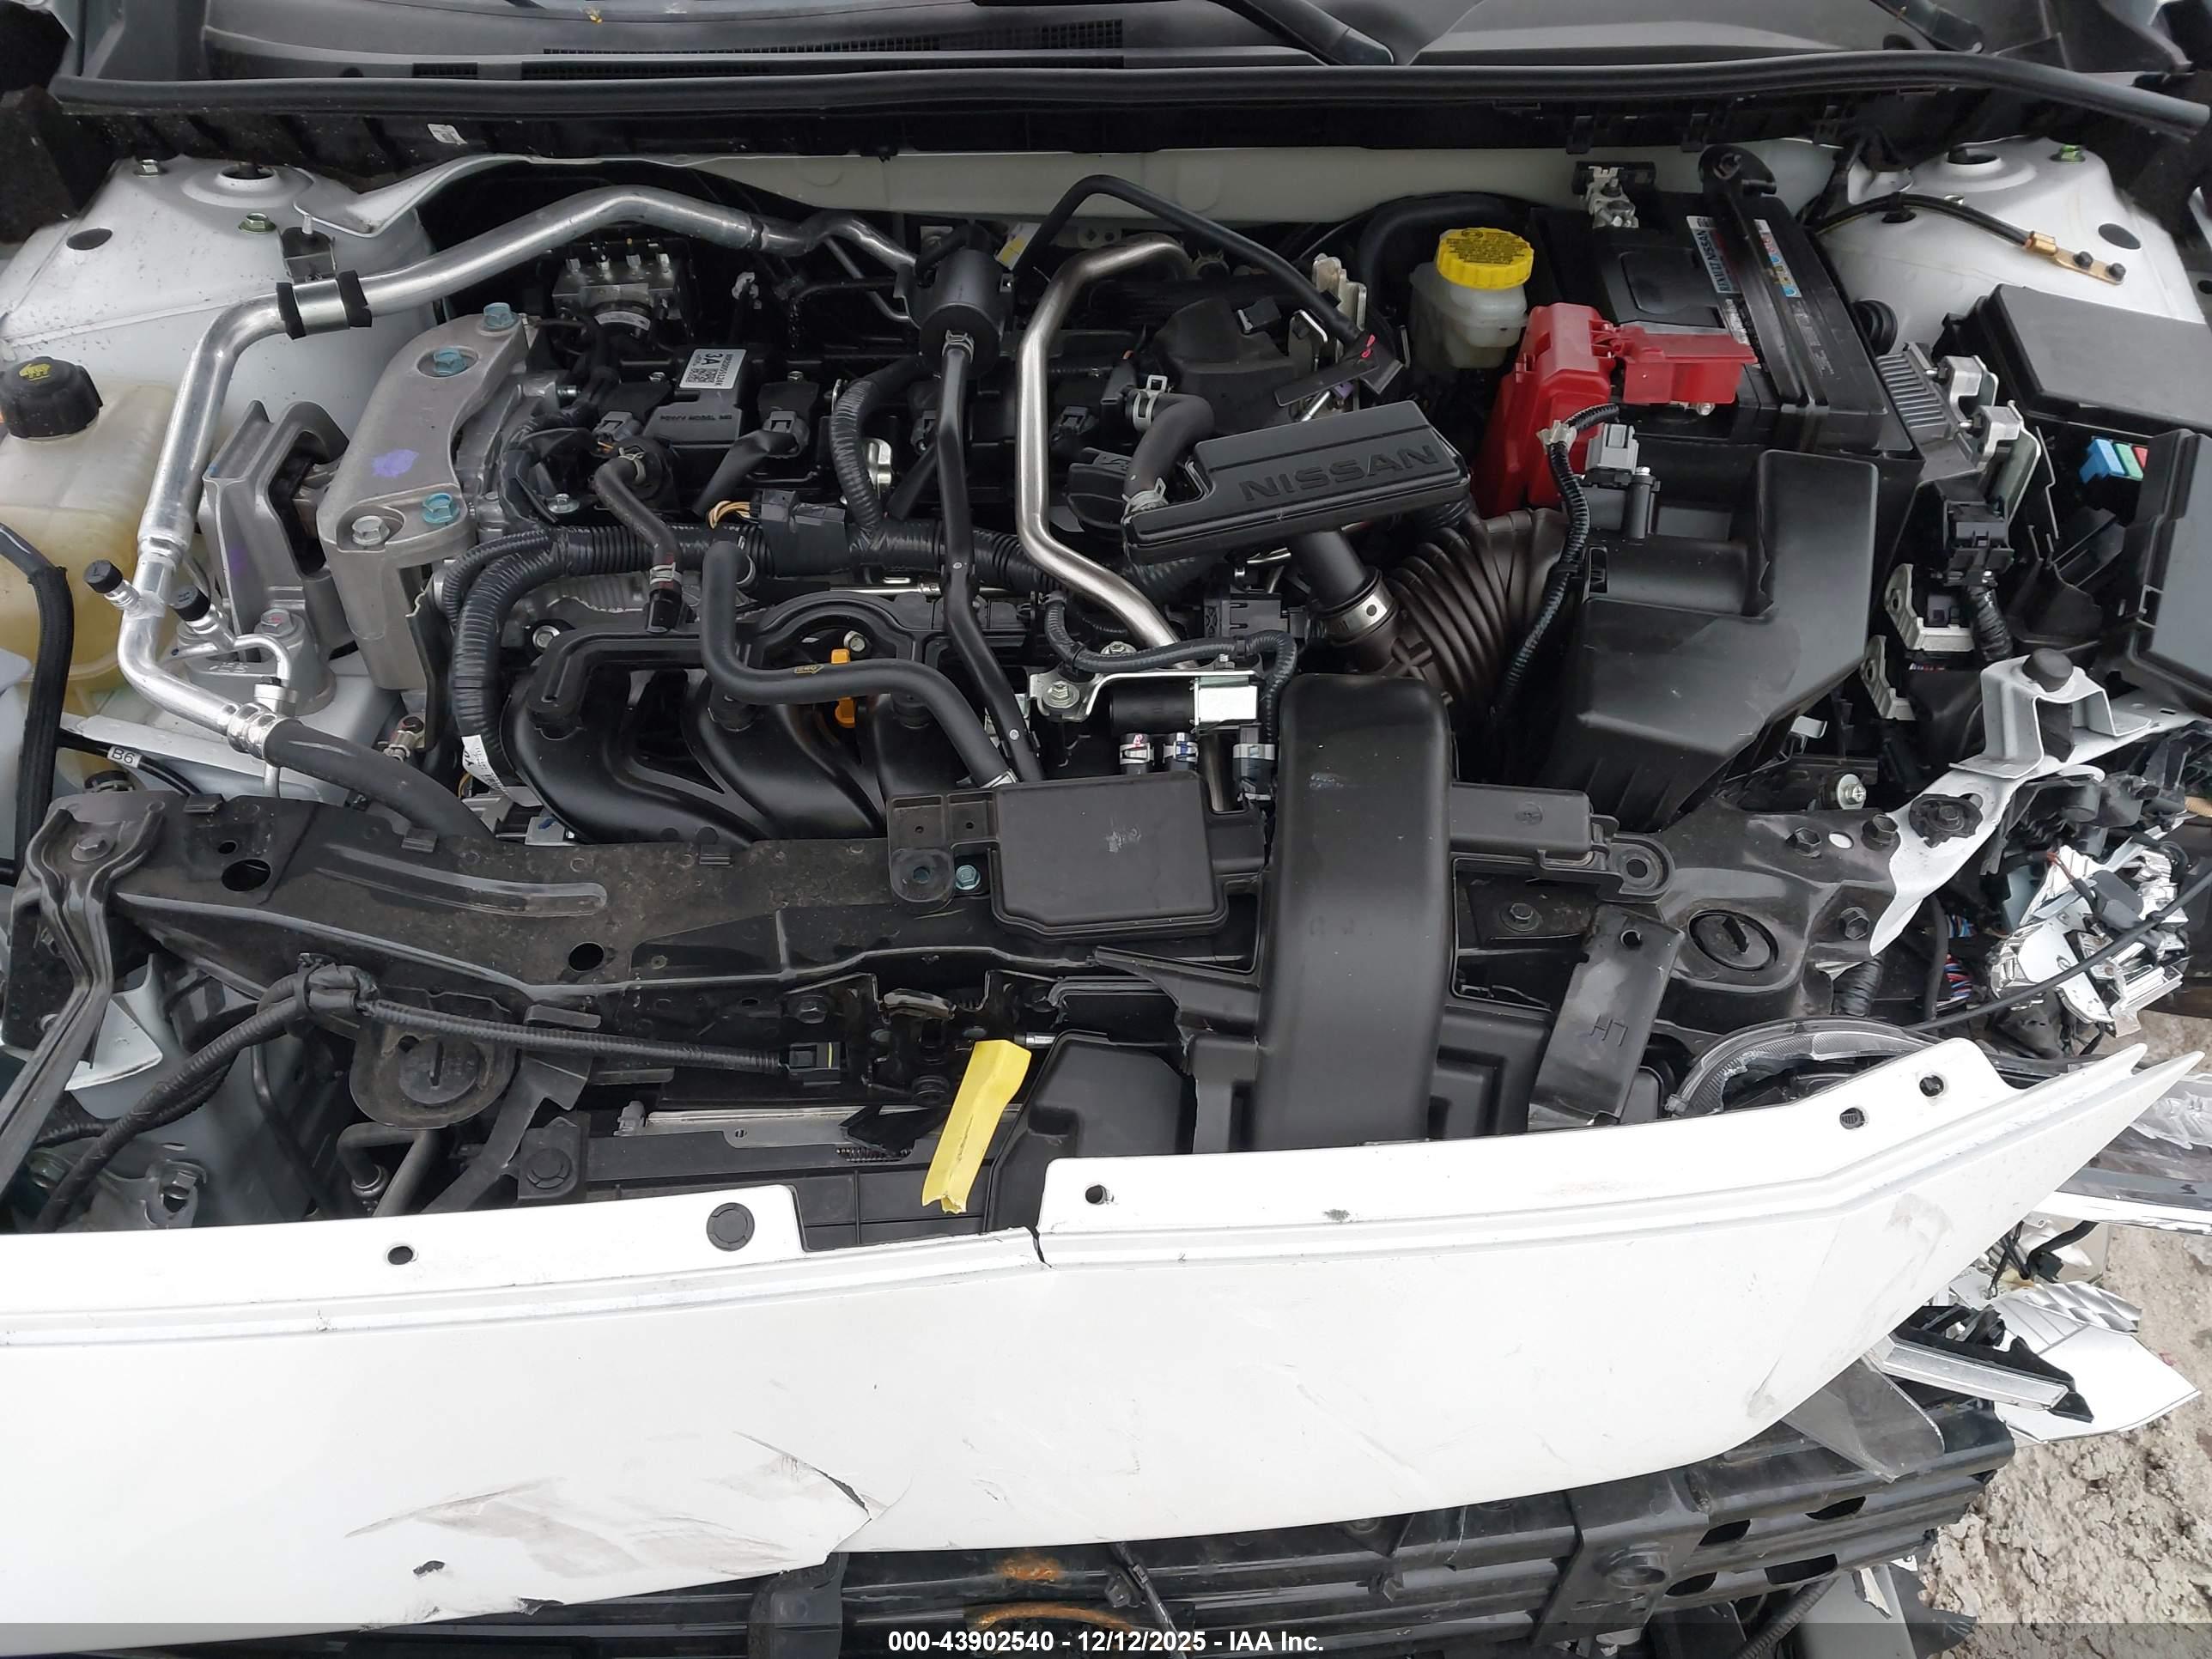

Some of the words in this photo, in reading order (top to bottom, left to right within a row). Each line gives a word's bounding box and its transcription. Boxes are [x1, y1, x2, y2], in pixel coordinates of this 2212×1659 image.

[1697, 230, 1717, 261] NISSAN
[702, 353, 722, 365] 3A
[1239, 445, 1439, 501] NISSAN
[112, 747, 135, 764] B6
